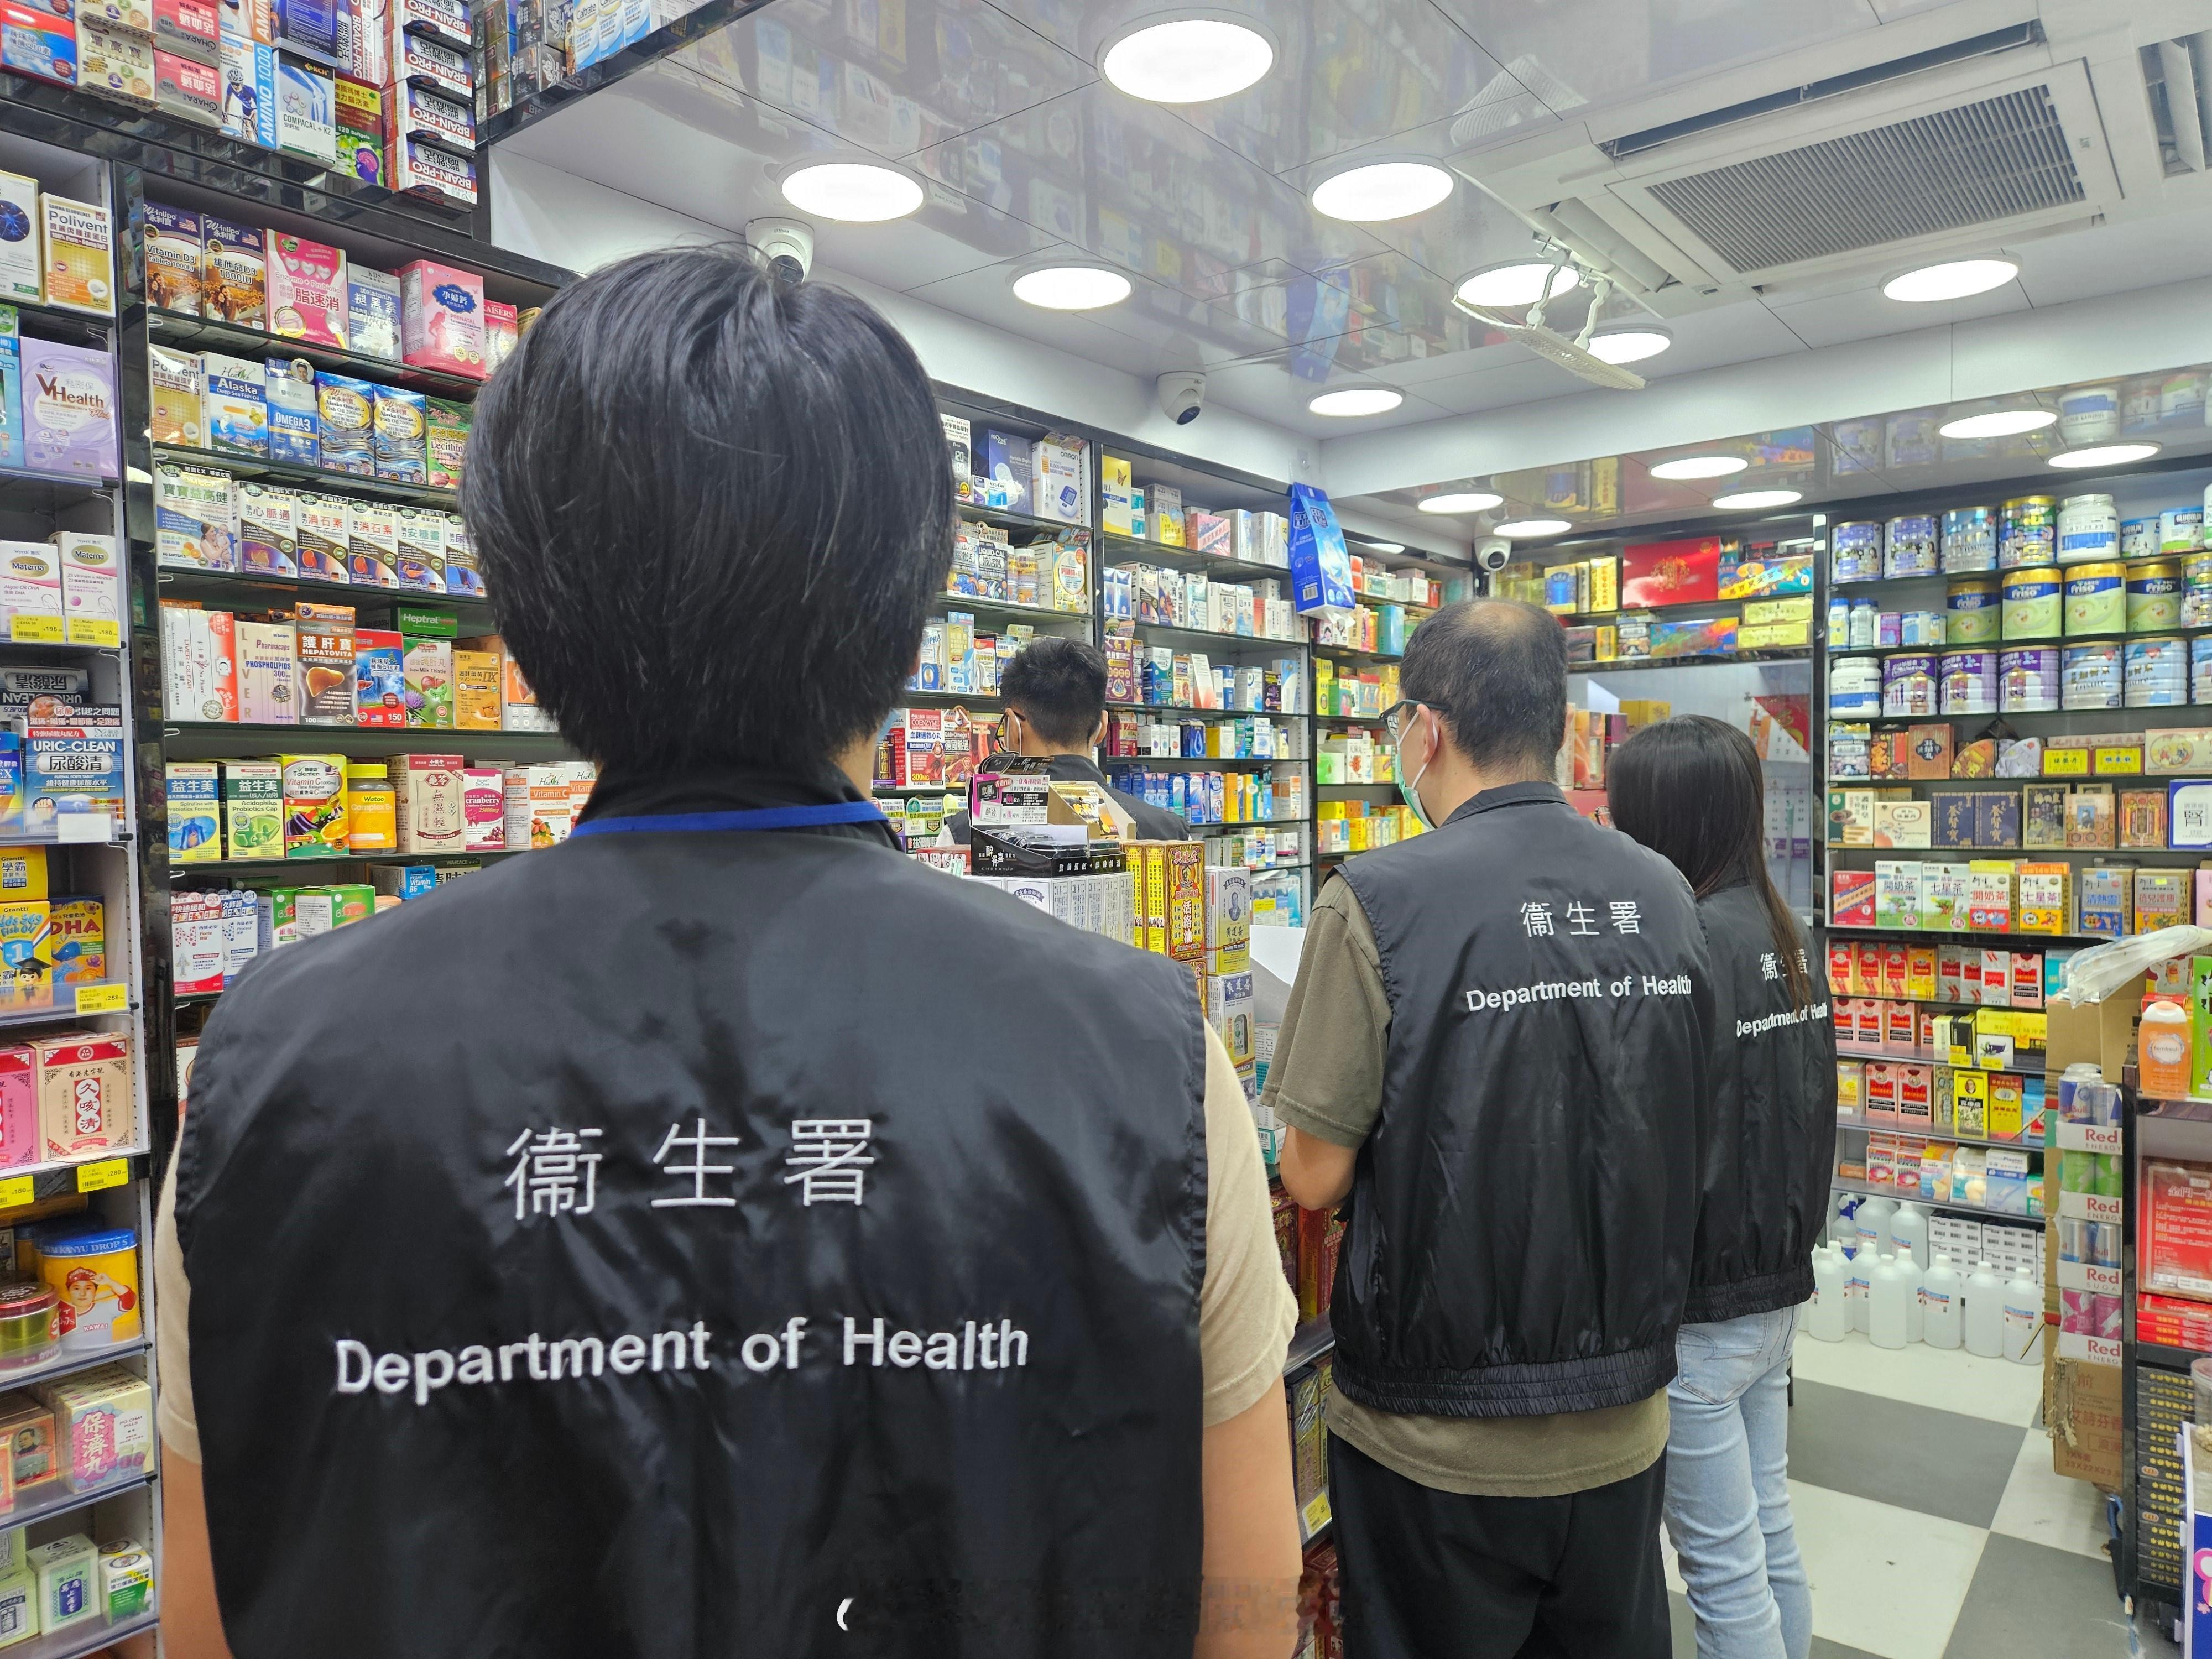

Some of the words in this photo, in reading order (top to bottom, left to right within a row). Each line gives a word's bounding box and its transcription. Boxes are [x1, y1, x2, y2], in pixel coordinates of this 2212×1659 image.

[408, 53, 467, 85] BRAIN-PRO
[284, 114, 318, 131] COMPACAL
[324, 127, 331, 136] K2
[413, 107, 470, 138] BRAIN-PRO
[413, 161, 472, 189] BRAIN-PRO
[49, 211, 108, 235] Polivent
[147, 244, 181, 261] Vitamin
[183, 252, 196, 264] D3
[275, 272, 302, 285] Enzyme
[295, 288, 340, 311] 脂速消
[218, 378, 258, 395] Alaska
[431, 441, 463, 451] Lecithin
[1060, 451, 1078, 460] OMRON
[75, 551, 105, 560] Materna
[12, 562, 44, 571] Materna
[404, 614, 438, 624] Heptral
[257, 639, 290, 650] Pharmacaps
[302, 635, 352, 651] 護肝寶
[302, 649, 353, 657] HEPATOVITA
[246, 660, 291, 670] PHOSPHOLIPIDS
[16, 674, 67, 690] 尿酸清
[33, 741, 115, 752] URIC-CLEAN
[49, 755, 102, 770] 尿酸清
[171, 780, 214, 792] 益生美
[239, 780, 278, 792] 益生美
[534, 790, 558, 798] Vitamin
[560, 789, 567, 797] C
[50, 919, 101, 935] DHA
[1466, 978, 1603, 1013] Department
[1610, 975, 1632, 997] of
[1642, 974, 1691, 995] Health
[1800, 1005, 1808, 1021] of
[2085, 1128, 2117, 1143] Red
[2086, 1143, 2121, 1151] ENERGY
[2087, 1197, 2119, 1213] Red
[2087, 1268, 2119, 1284] Red
[2088, 1340, 2121, 1356] Red
[336, 1321, 711, 1405] Department
[741, 1317, 807, 1372] of
[843, 1316, 1029, 1370] Health
[80, 1411, 108, 1478] 保濟丸
